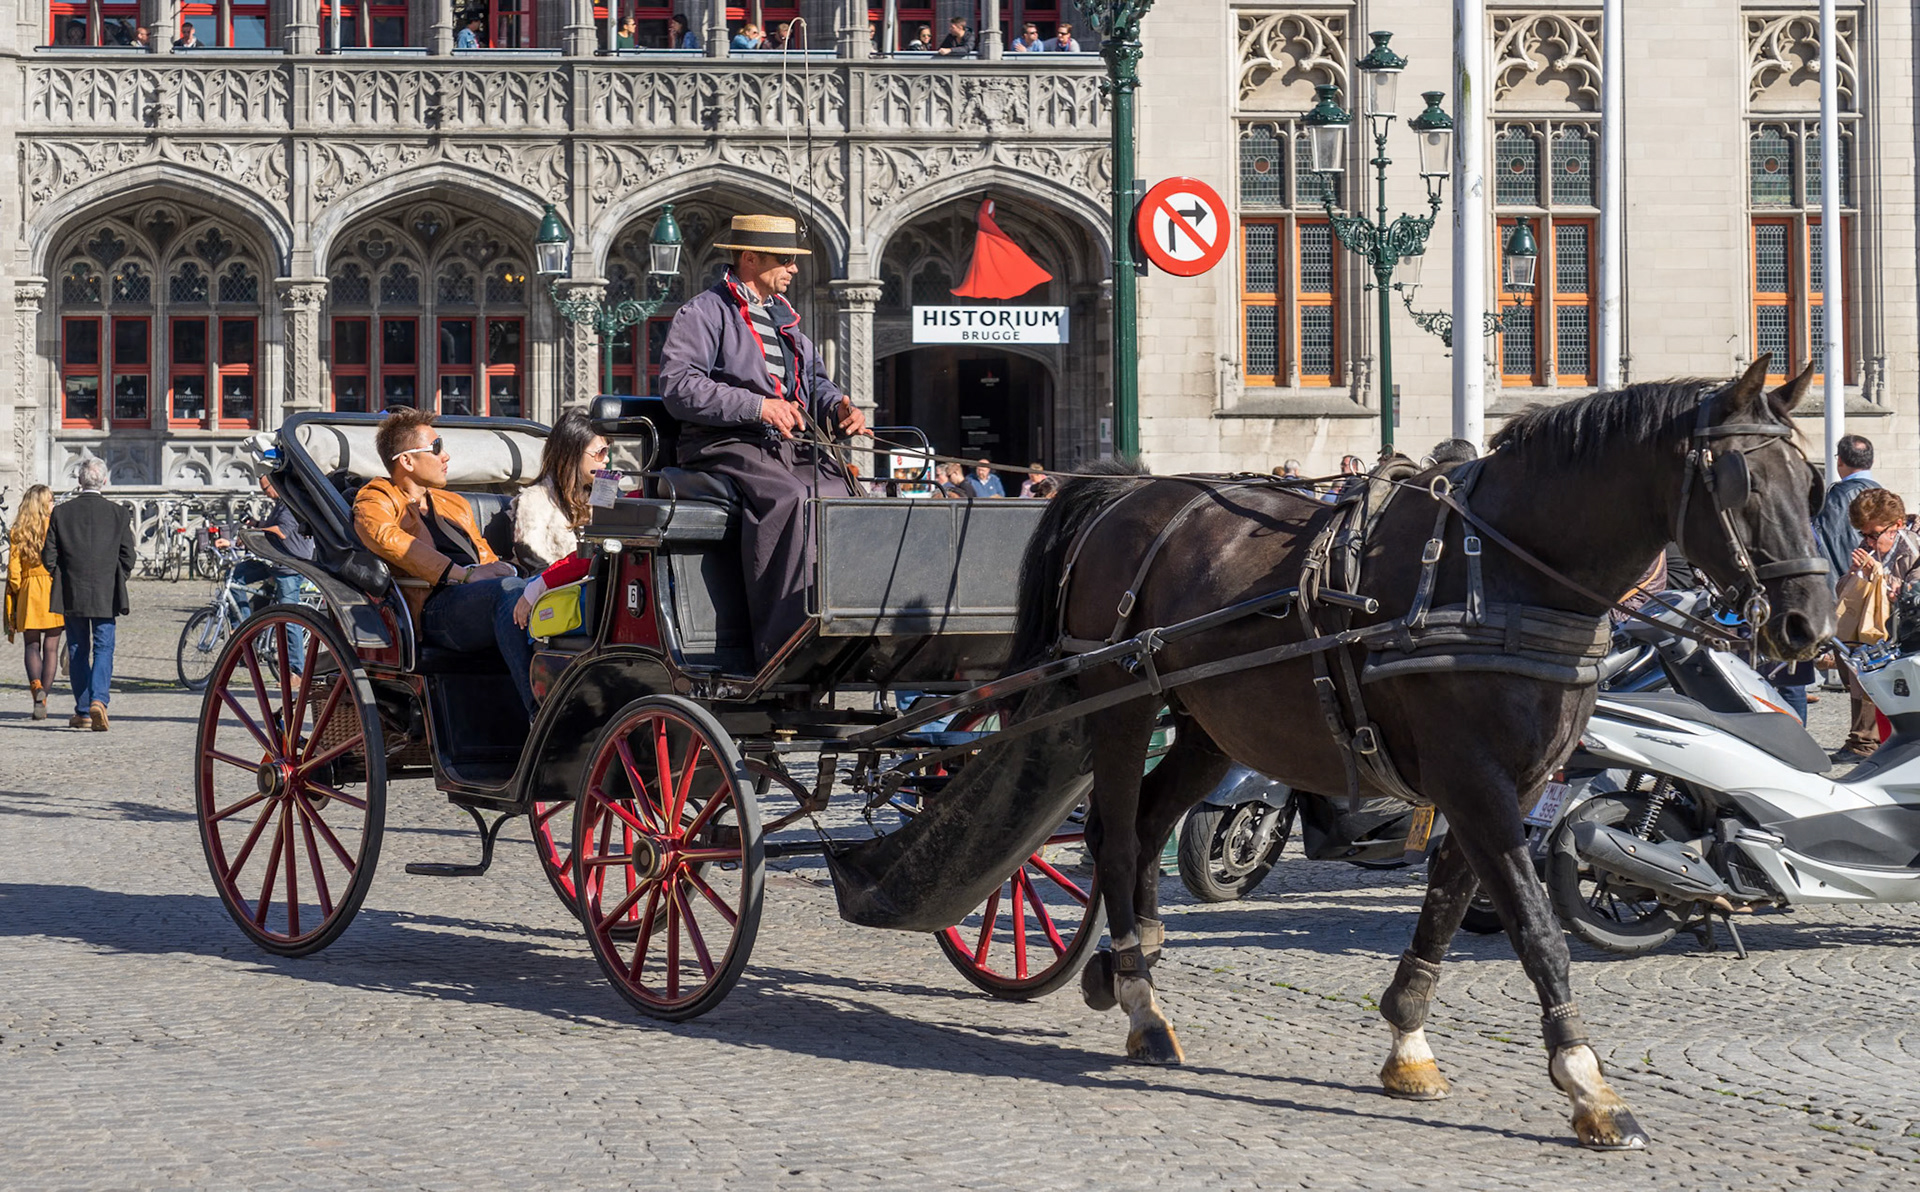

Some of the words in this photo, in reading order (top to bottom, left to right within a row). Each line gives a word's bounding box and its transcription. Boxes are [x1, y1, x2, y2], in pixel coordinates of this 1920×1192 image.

[923, 310, 1060, 330] HISTORIUM
[962, 331, 1021, 340] BRUGGE
[631, 588, 637, 603] 6
[1539, 802, 1560, 819] 995
